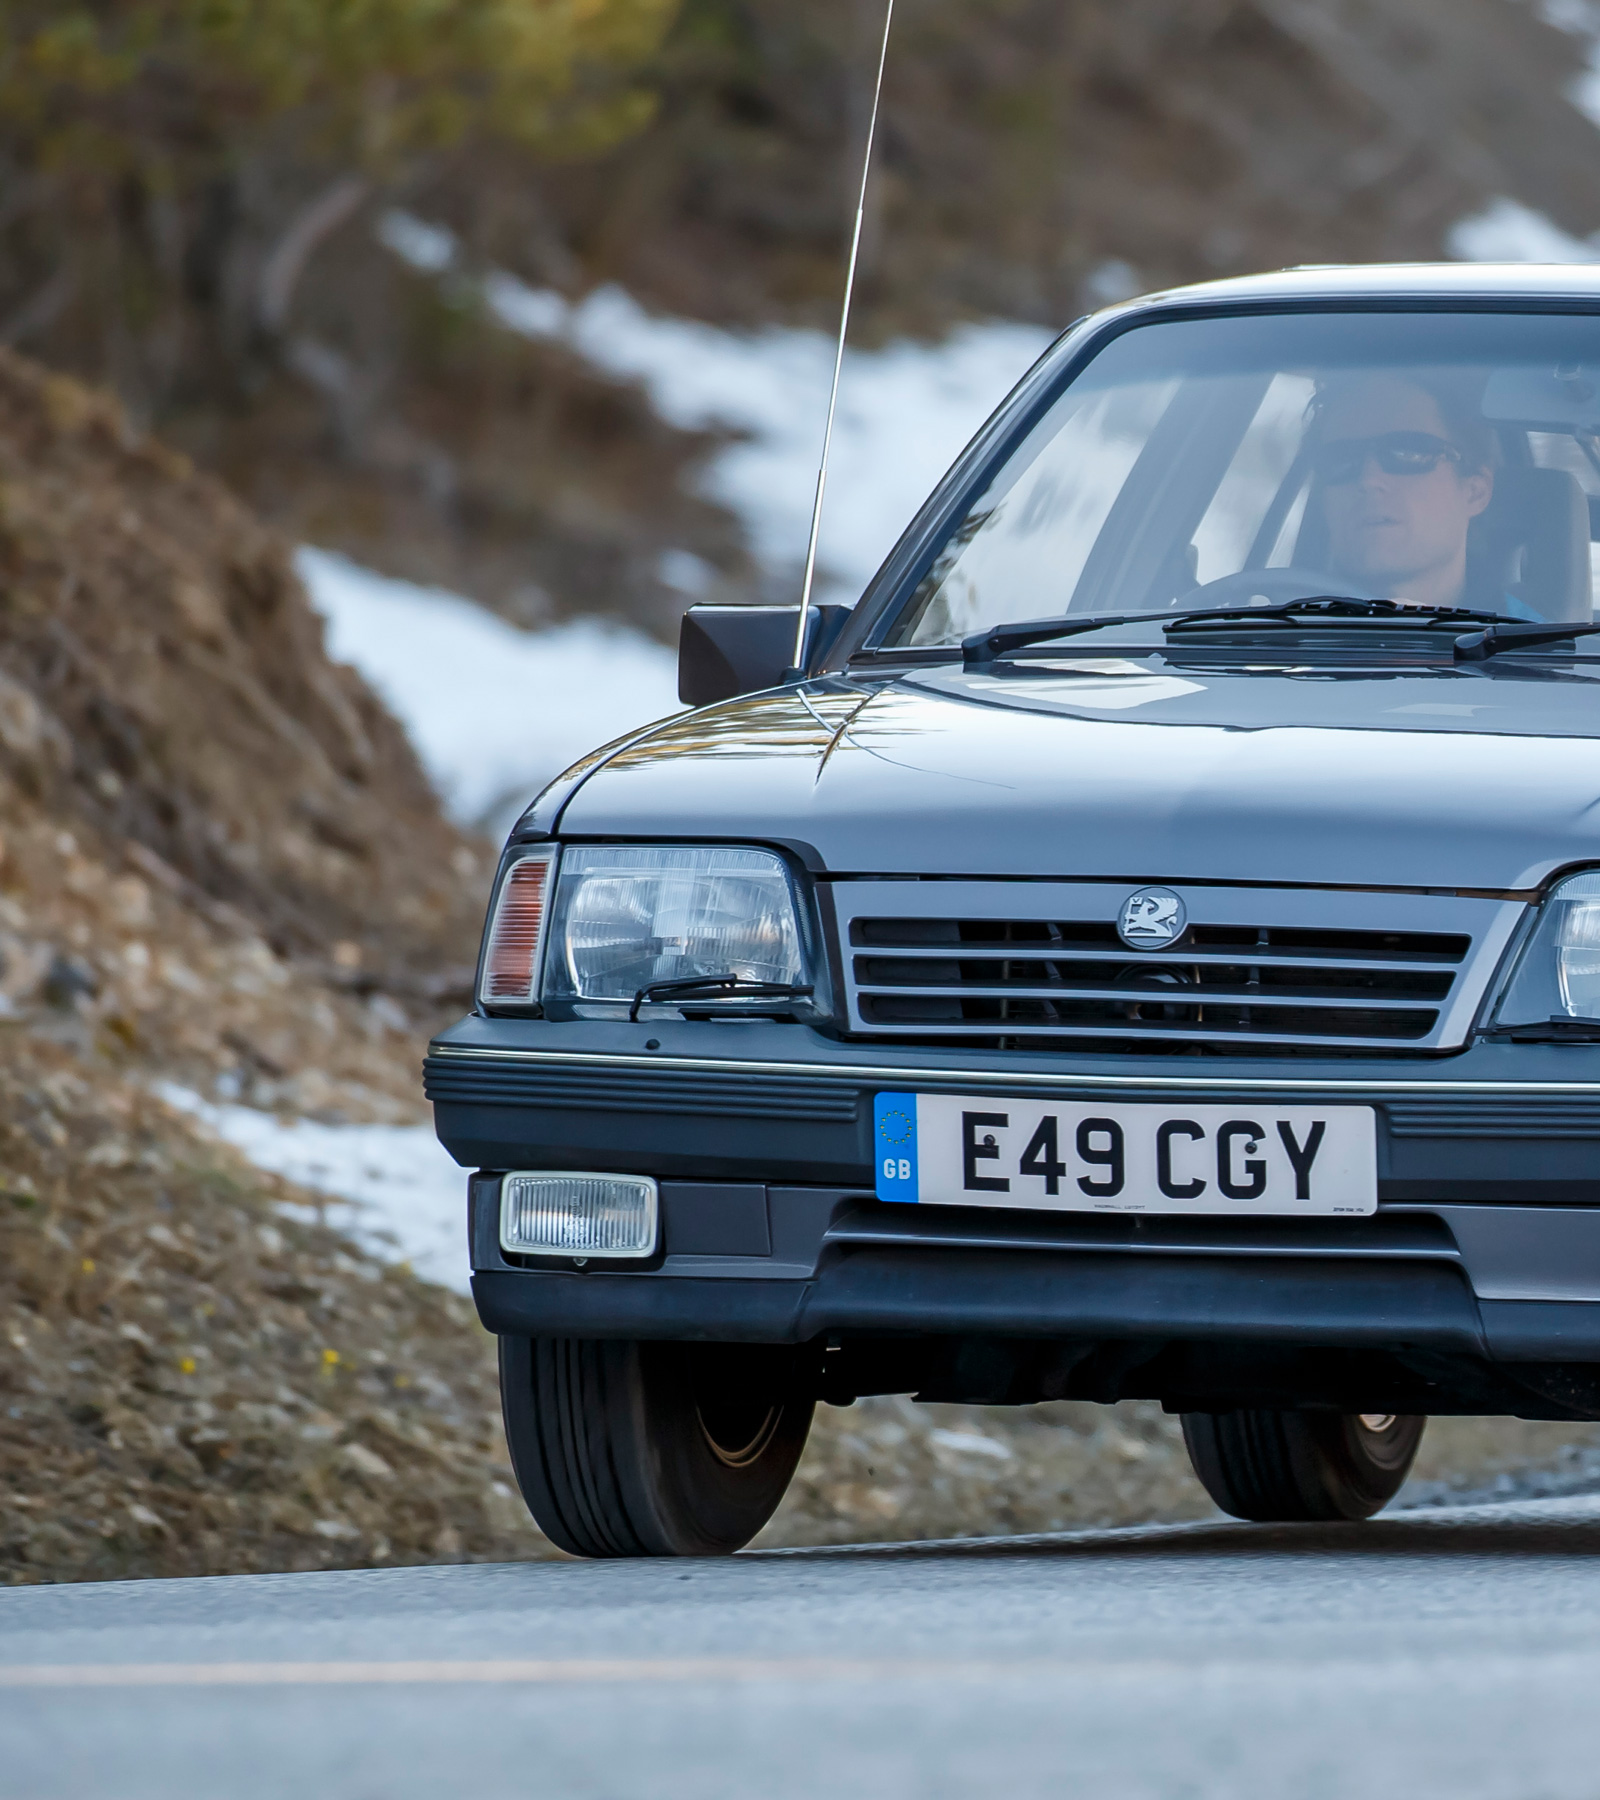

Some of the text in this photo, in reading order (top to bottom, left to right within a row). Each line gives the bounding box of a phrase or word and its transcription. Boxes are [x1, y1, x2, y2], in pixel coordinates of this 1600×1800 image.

[883, 1158, 911, 1180] GB
[961, 1110, 1327, 1200] E49 CGY
